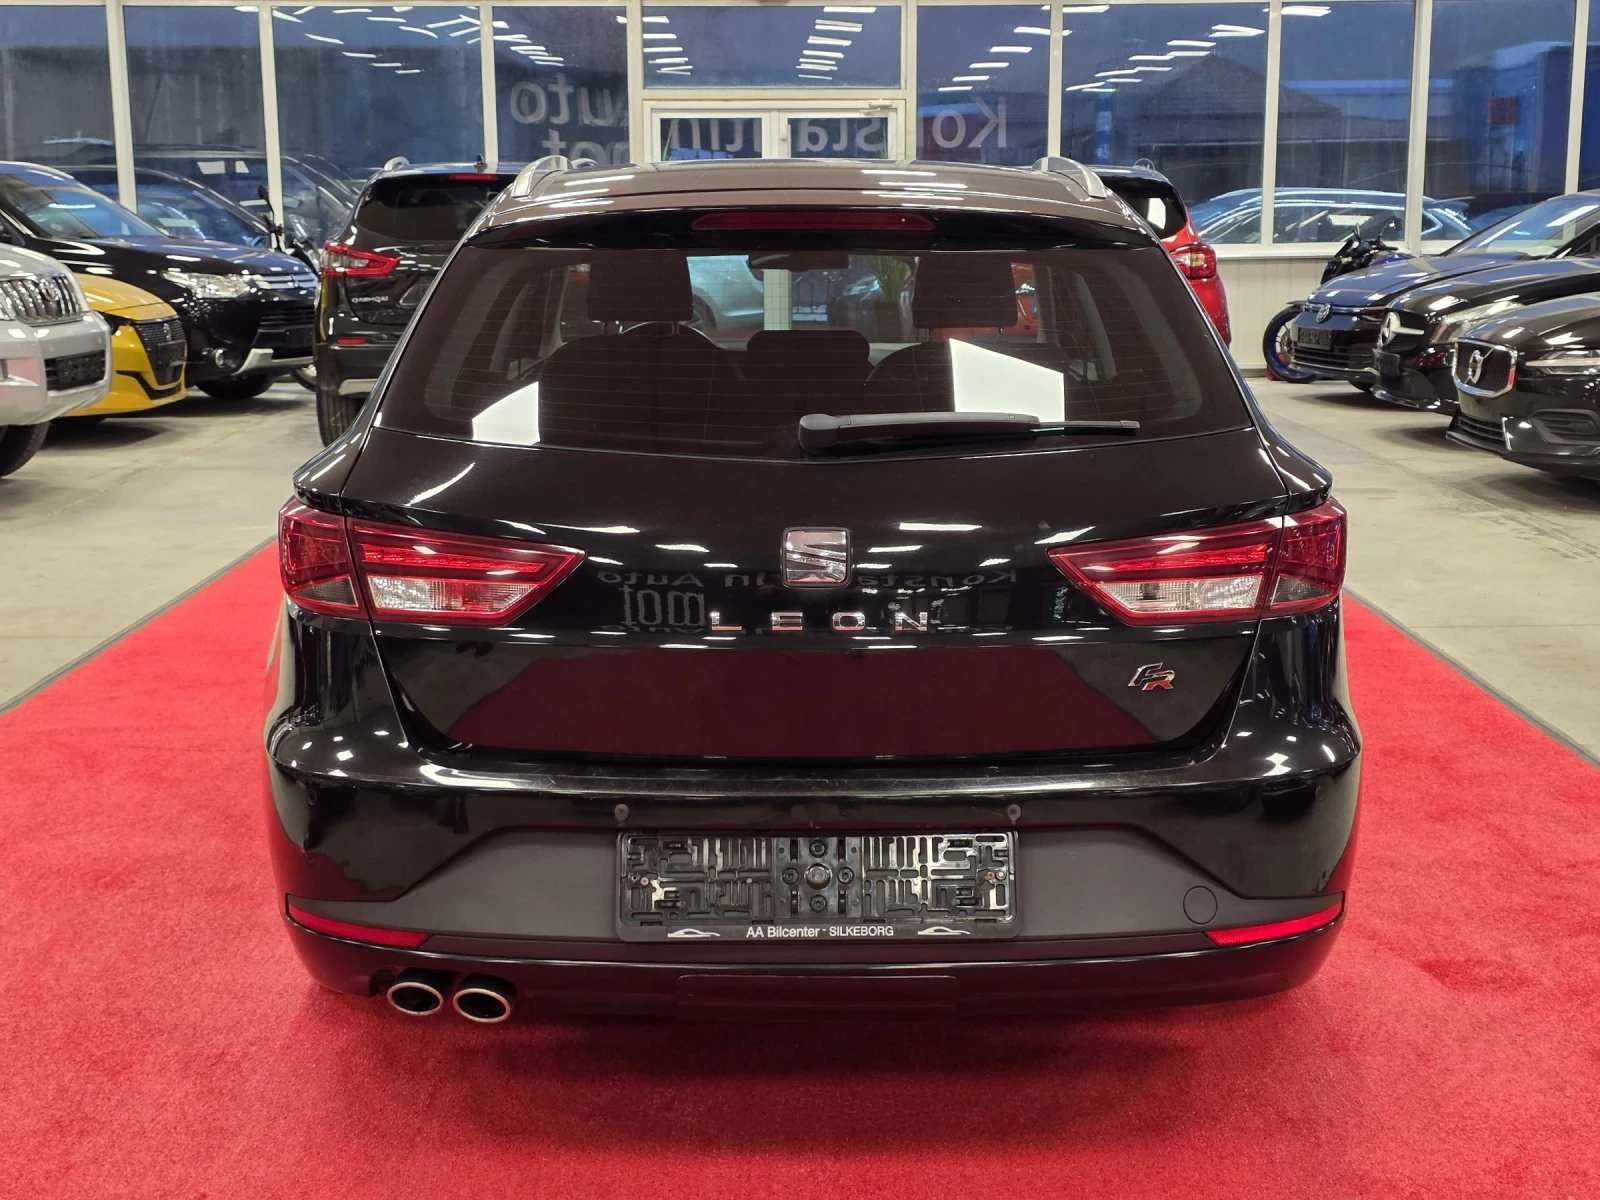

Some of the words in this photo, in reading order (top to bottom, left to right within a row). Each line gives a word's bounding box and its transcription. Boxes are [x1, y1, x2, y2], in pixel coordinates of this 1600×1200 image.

[710, 611, 928, 631] LEON
[1127, 662, 1176, 691] FR
[746, 927, 764, 938] AA
[767, 926, 820, 938] Bilcenter
[829, 925, 894, 937] SILKEBORG
